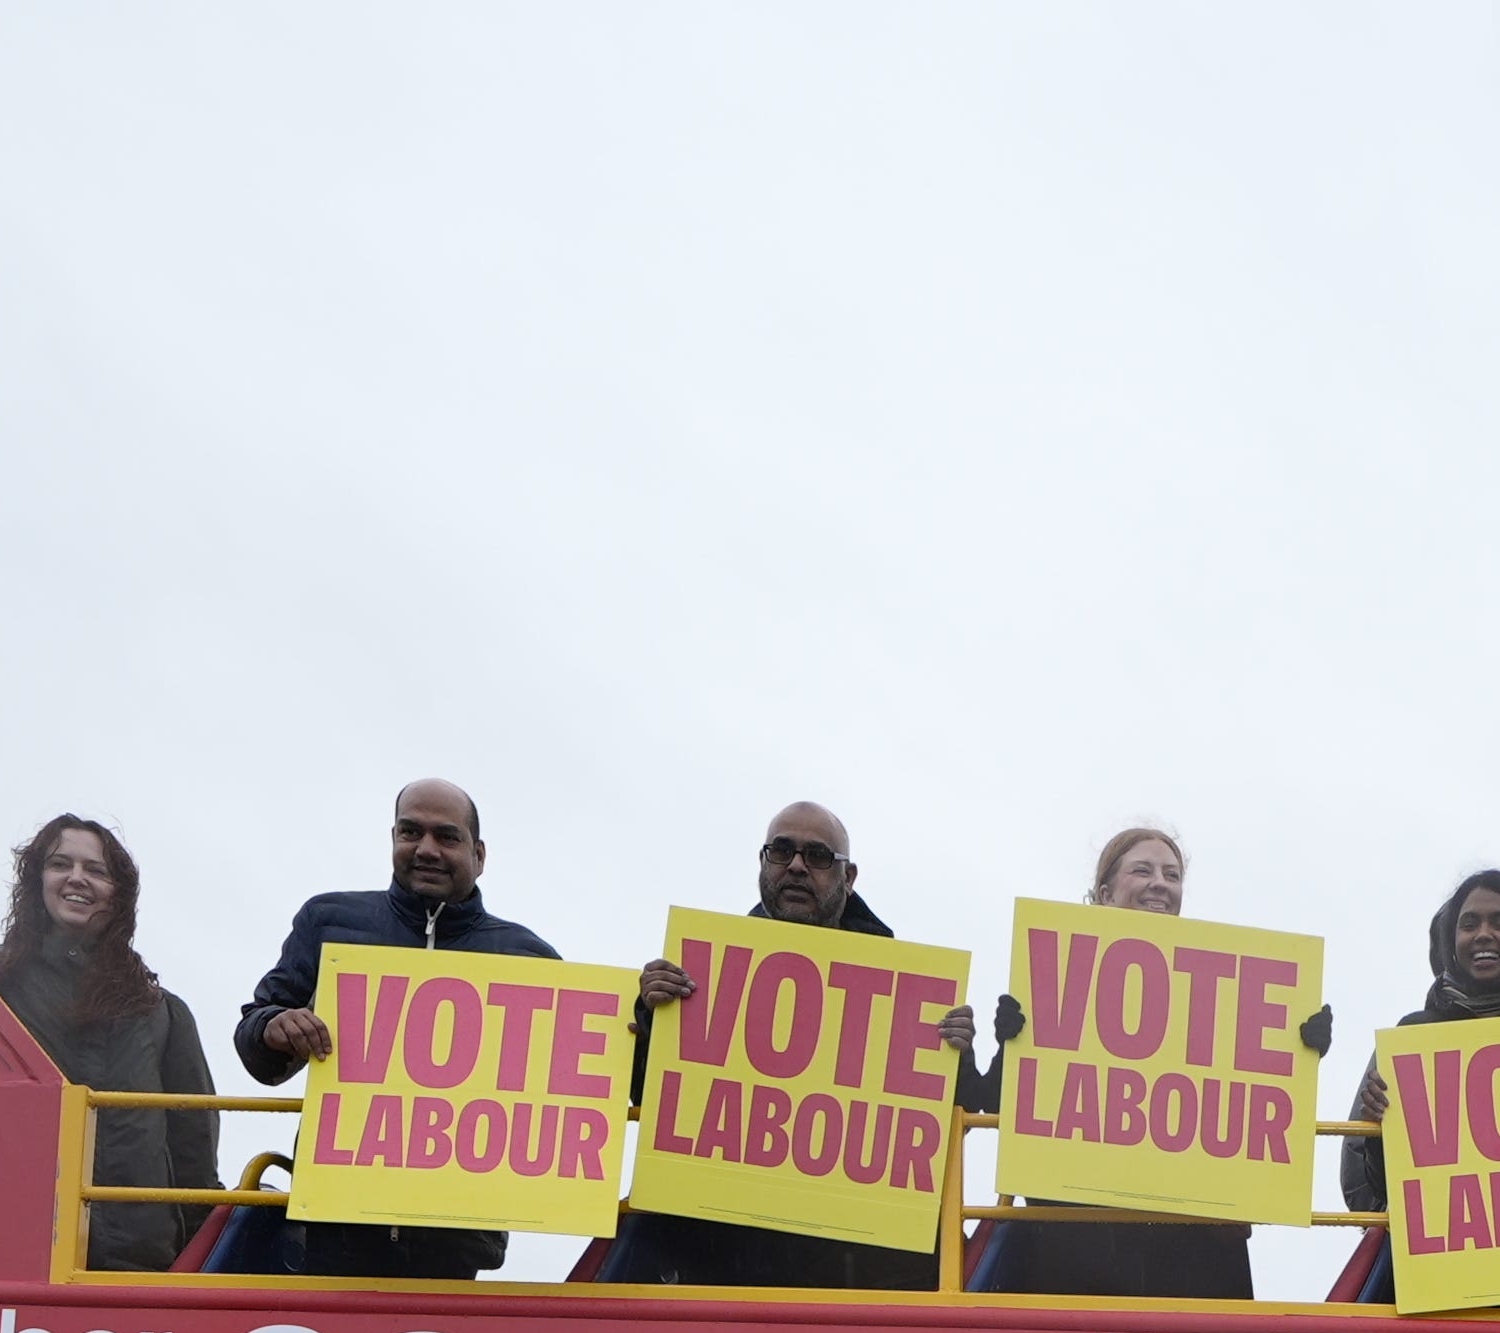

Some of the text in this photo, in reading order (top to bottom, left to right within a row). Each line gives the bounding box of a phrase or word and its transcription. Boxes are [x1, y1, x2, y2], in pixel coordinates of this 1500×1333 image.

[337, 973, 620, 1098] VOTE
[680, 938, 958, 1101] VOTE
[1028, 928, 1299, 1077] VOTE
[313, 1093, 609, 1180] LABOUR
[654, 1070, 941, 1193] LABOUR
[1015, 1058, 1293, 1164] LABOUR
